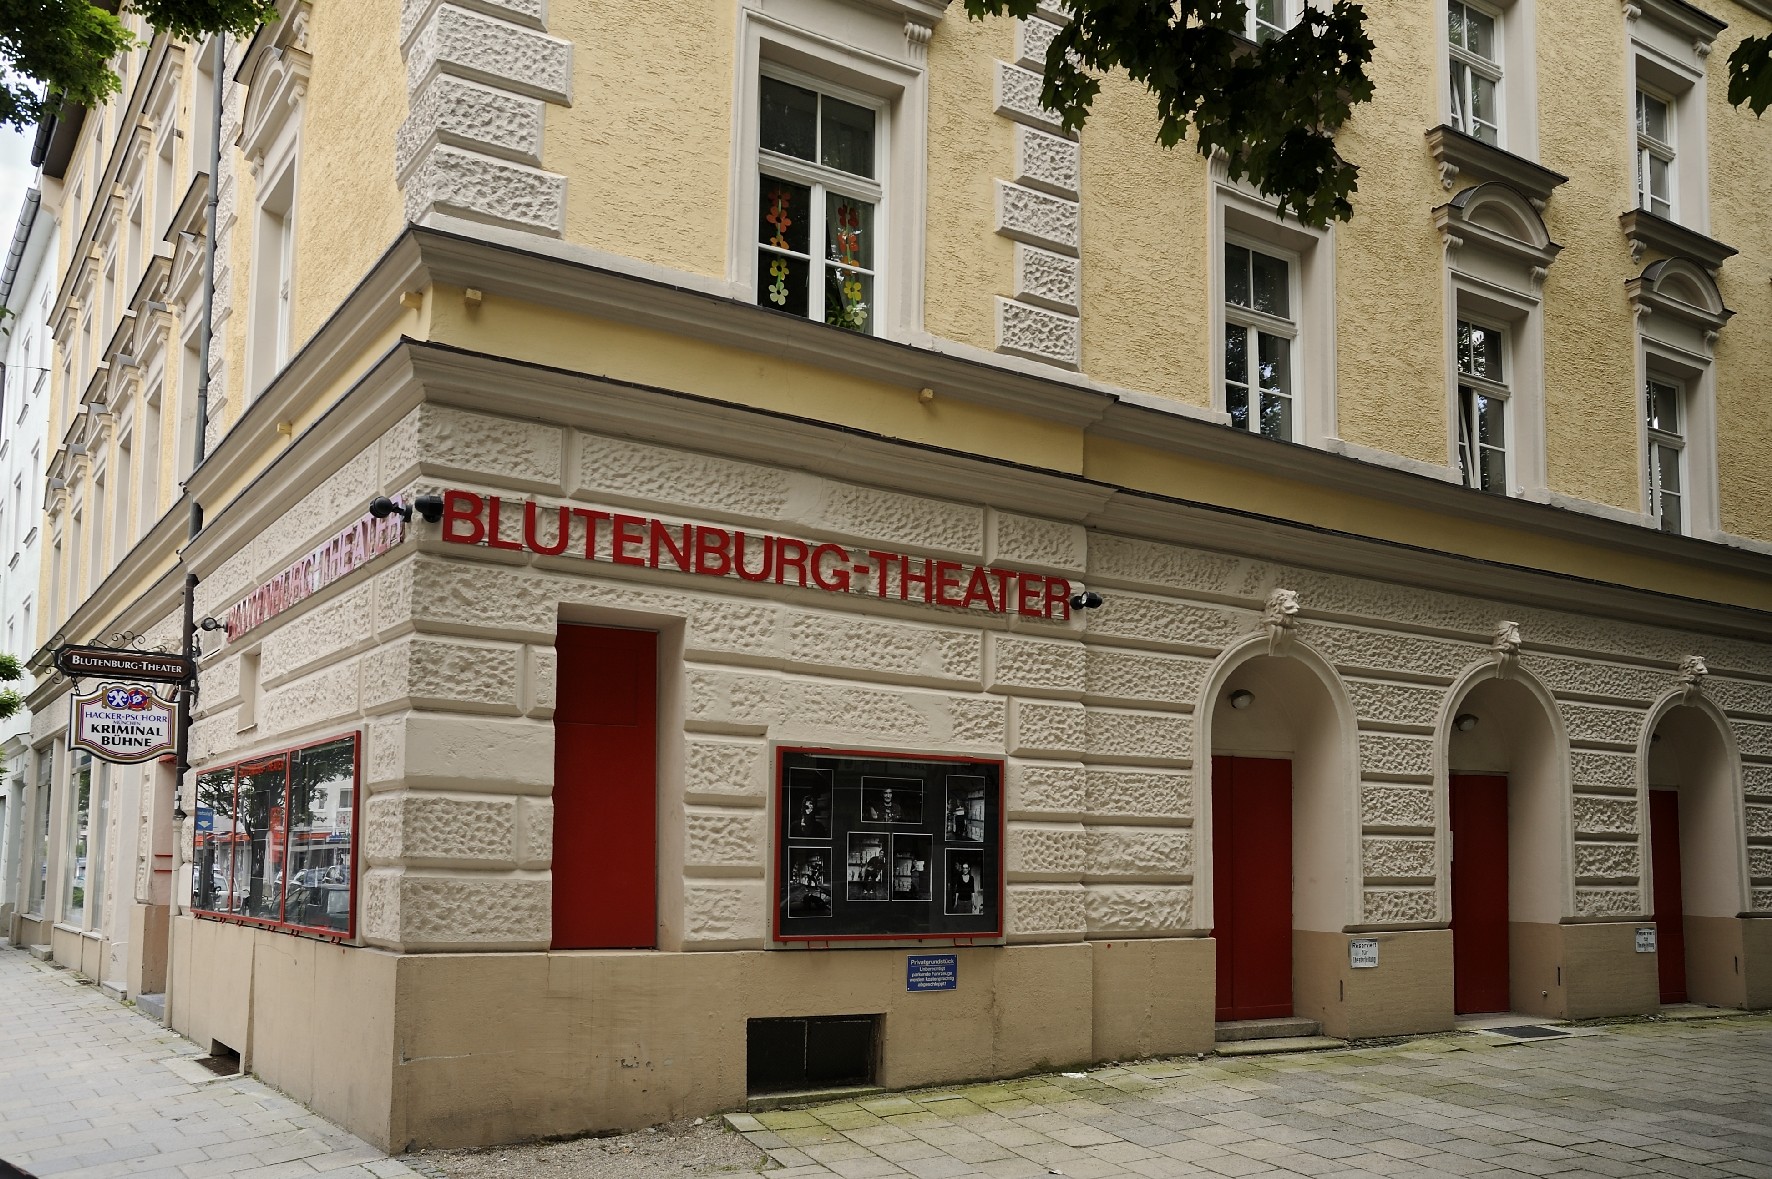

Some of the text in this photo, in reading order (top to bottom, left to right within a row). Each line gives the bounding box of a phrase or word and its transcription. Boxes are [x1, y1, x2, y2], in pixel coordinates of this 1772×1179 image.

[442, 489, 1072, 622] BLUTENBURG-THEATER
[72, 655, 182, 673] BLUTENBURG-THEATER
[85, 711, 168, 722] HACKER-PSCHORR
[91, 724, 164, 737] KRIMINAL
[101, 735, 152, 747] BÜHNE
[911, 958, 954, 966] Privatgrundstück
